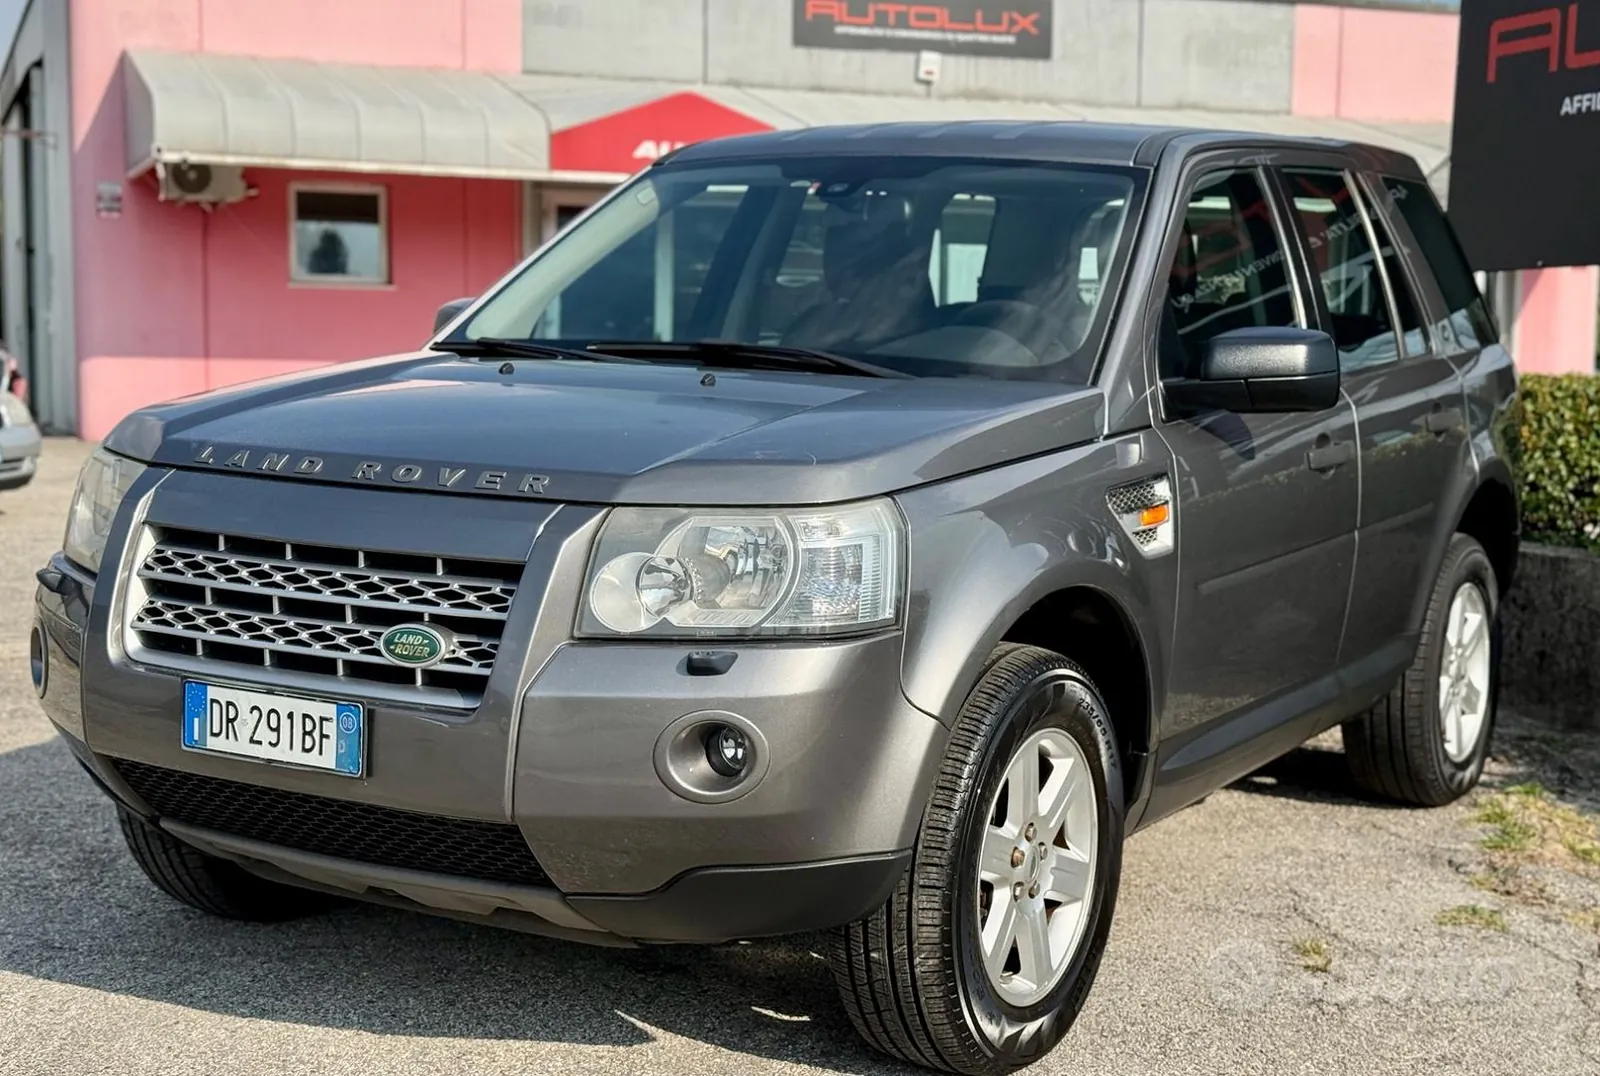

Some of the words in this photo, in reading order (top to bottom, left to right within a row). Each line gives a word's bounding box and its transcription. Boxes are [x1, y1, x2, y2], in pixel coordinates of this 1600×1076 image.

[806, 0, 1039, 35] AUTOLUX
[194, 445, 324, 475] LAND
[351, 460, 551, 494] ROVER
[393, 633, 424, 645] LAND
[394, 643, 431, 658] ROVER
[209, 698, 240, 742] DR
[248, 705, 334, 756] 291BF
